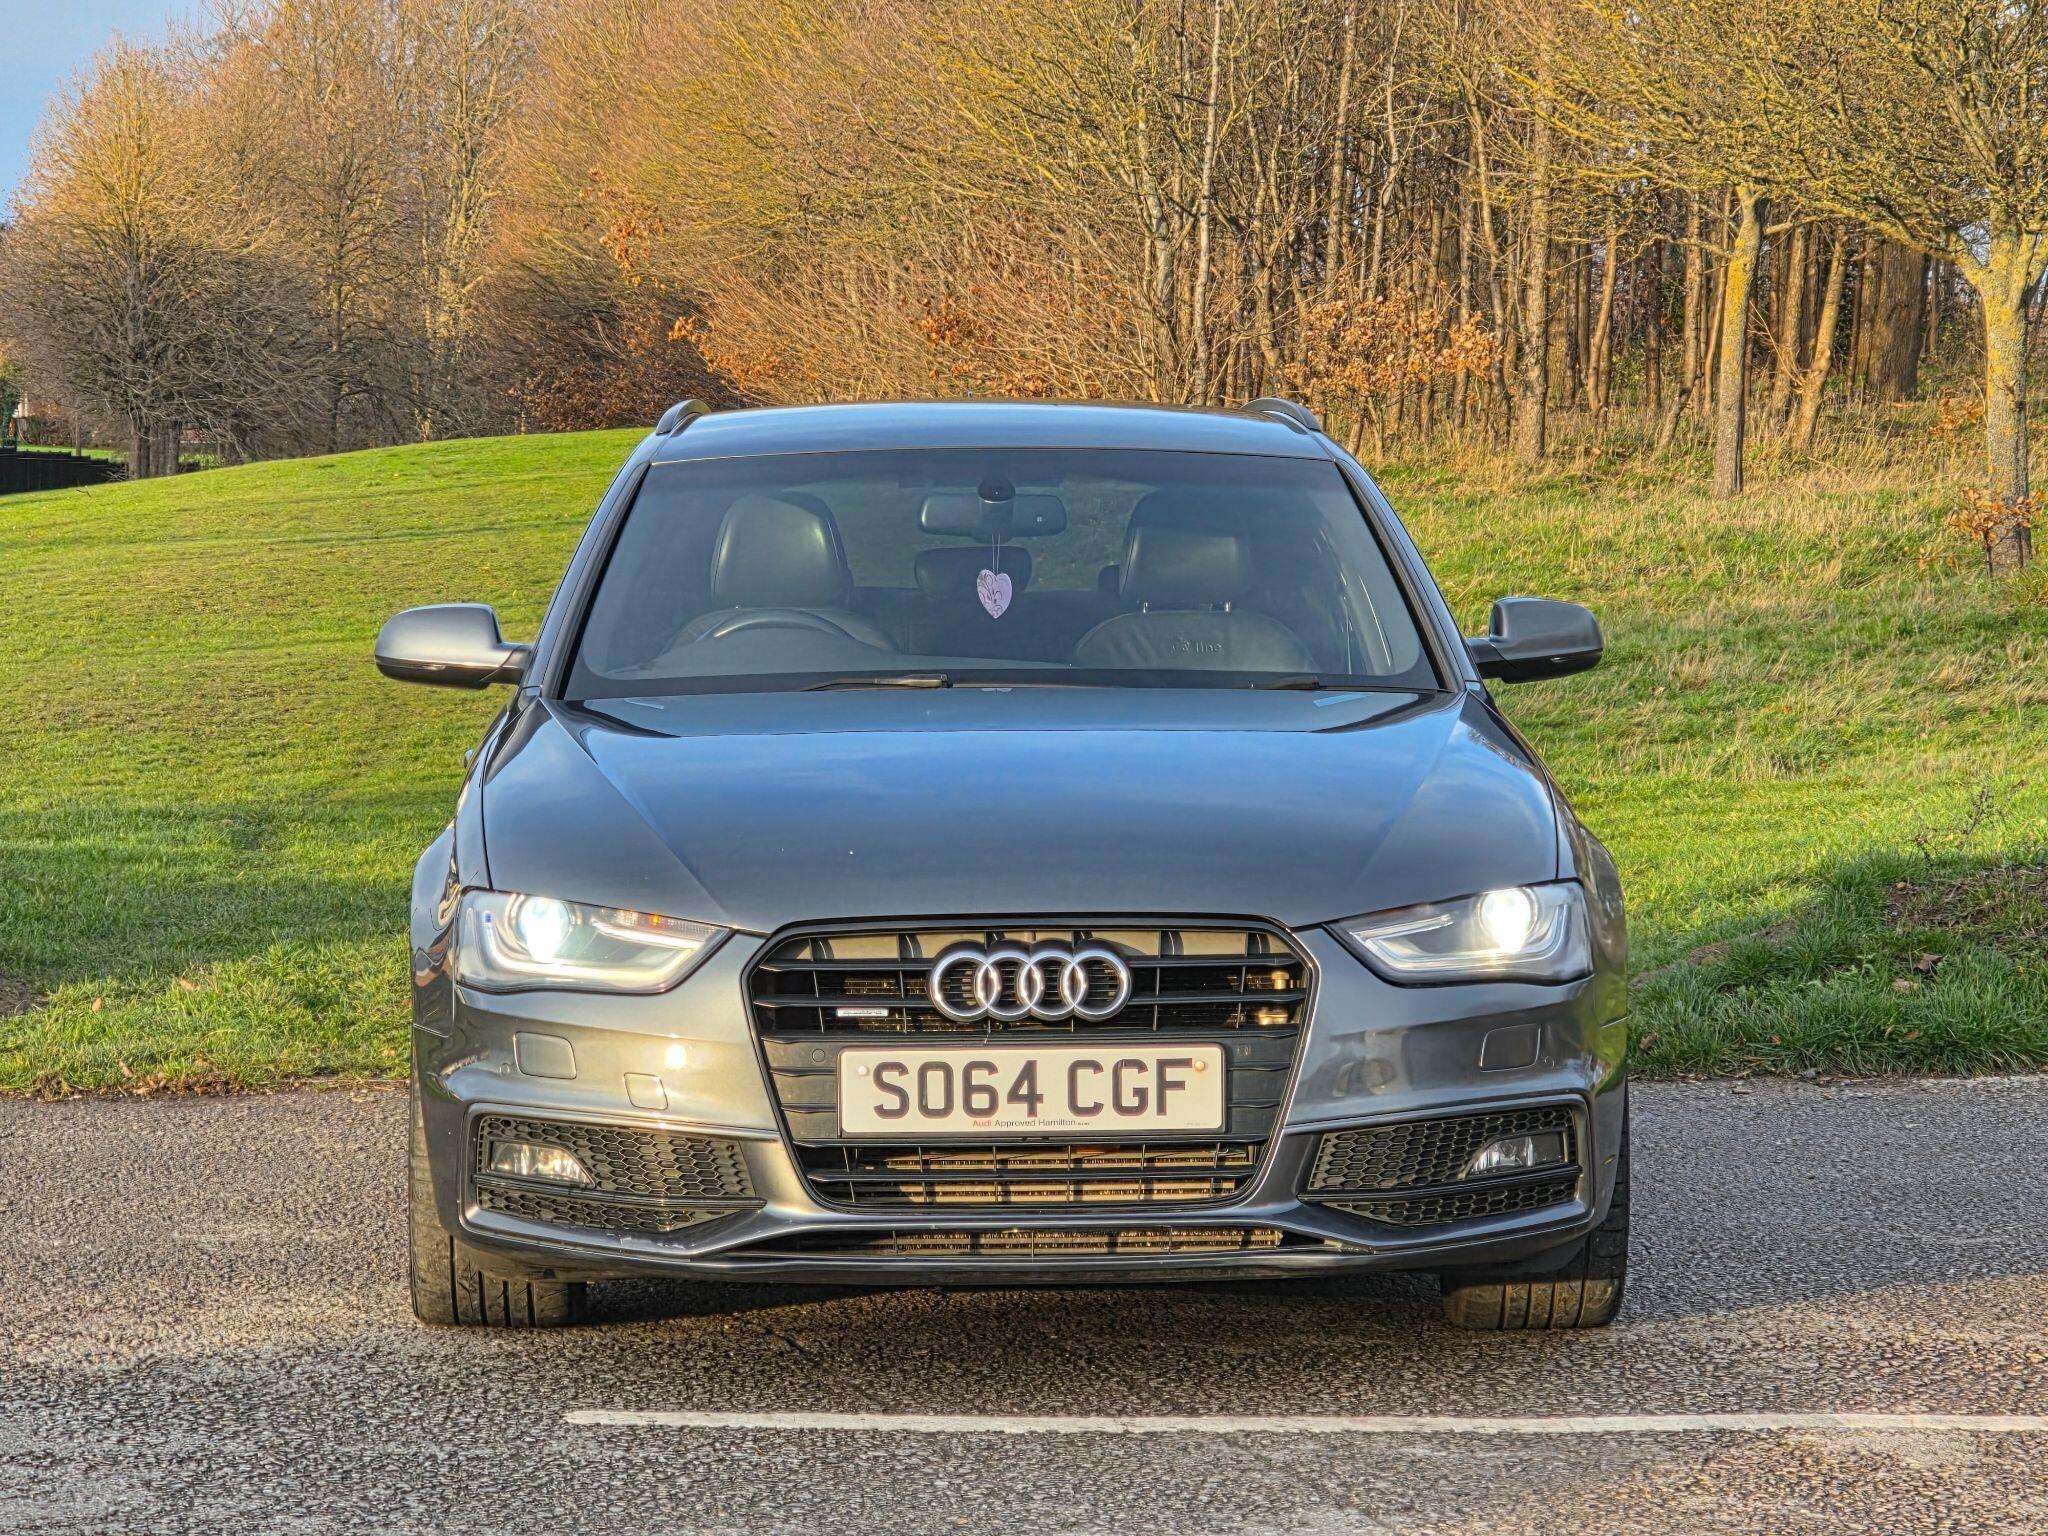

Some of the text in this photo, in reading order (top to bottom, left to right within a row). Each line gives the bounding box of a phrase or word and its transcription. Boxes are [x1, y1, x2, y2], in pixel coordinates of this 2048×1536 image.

[872, 1058, 1193, 1119] SO64 CGF
[972, 1119, 993, 1128] Audi
[994, 1119, 1037, 1129] Approved
[1038, 1118, 1077, 1127] Hamilton
